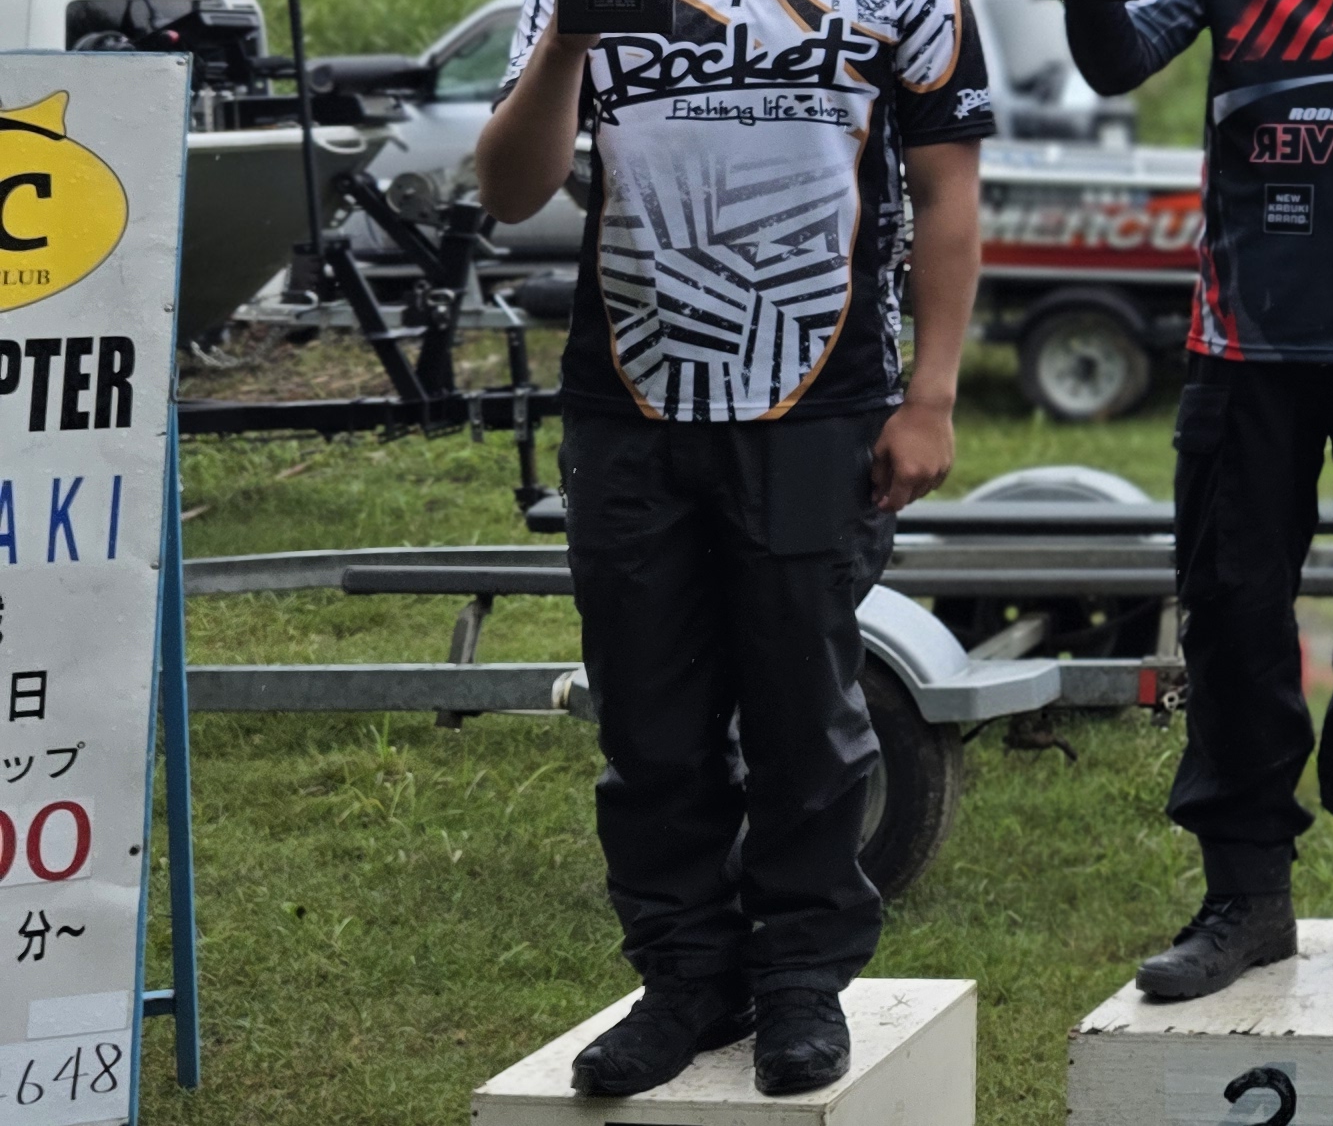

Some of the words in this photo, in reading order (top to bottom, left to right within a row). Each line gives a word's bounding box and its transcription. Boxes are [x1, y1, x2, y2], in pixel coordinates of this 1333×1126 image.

[597, 17, 873, 96] Rocket
[672, 97, 756, 125] Fishing
[763, 95, 798, 118] life
[804, 96, 849, 124] shop
[0, 173, 52, 252] C
[1268, 204, 1309, 213] KABUKI
[1275, 194, 1301, 203] NEW
[981, 205, 1204, 251] MERCU
[0, 268, 50, 285] LUB
[9, 670, 47, 721] 日
[0, 800, 92, 881] 0
